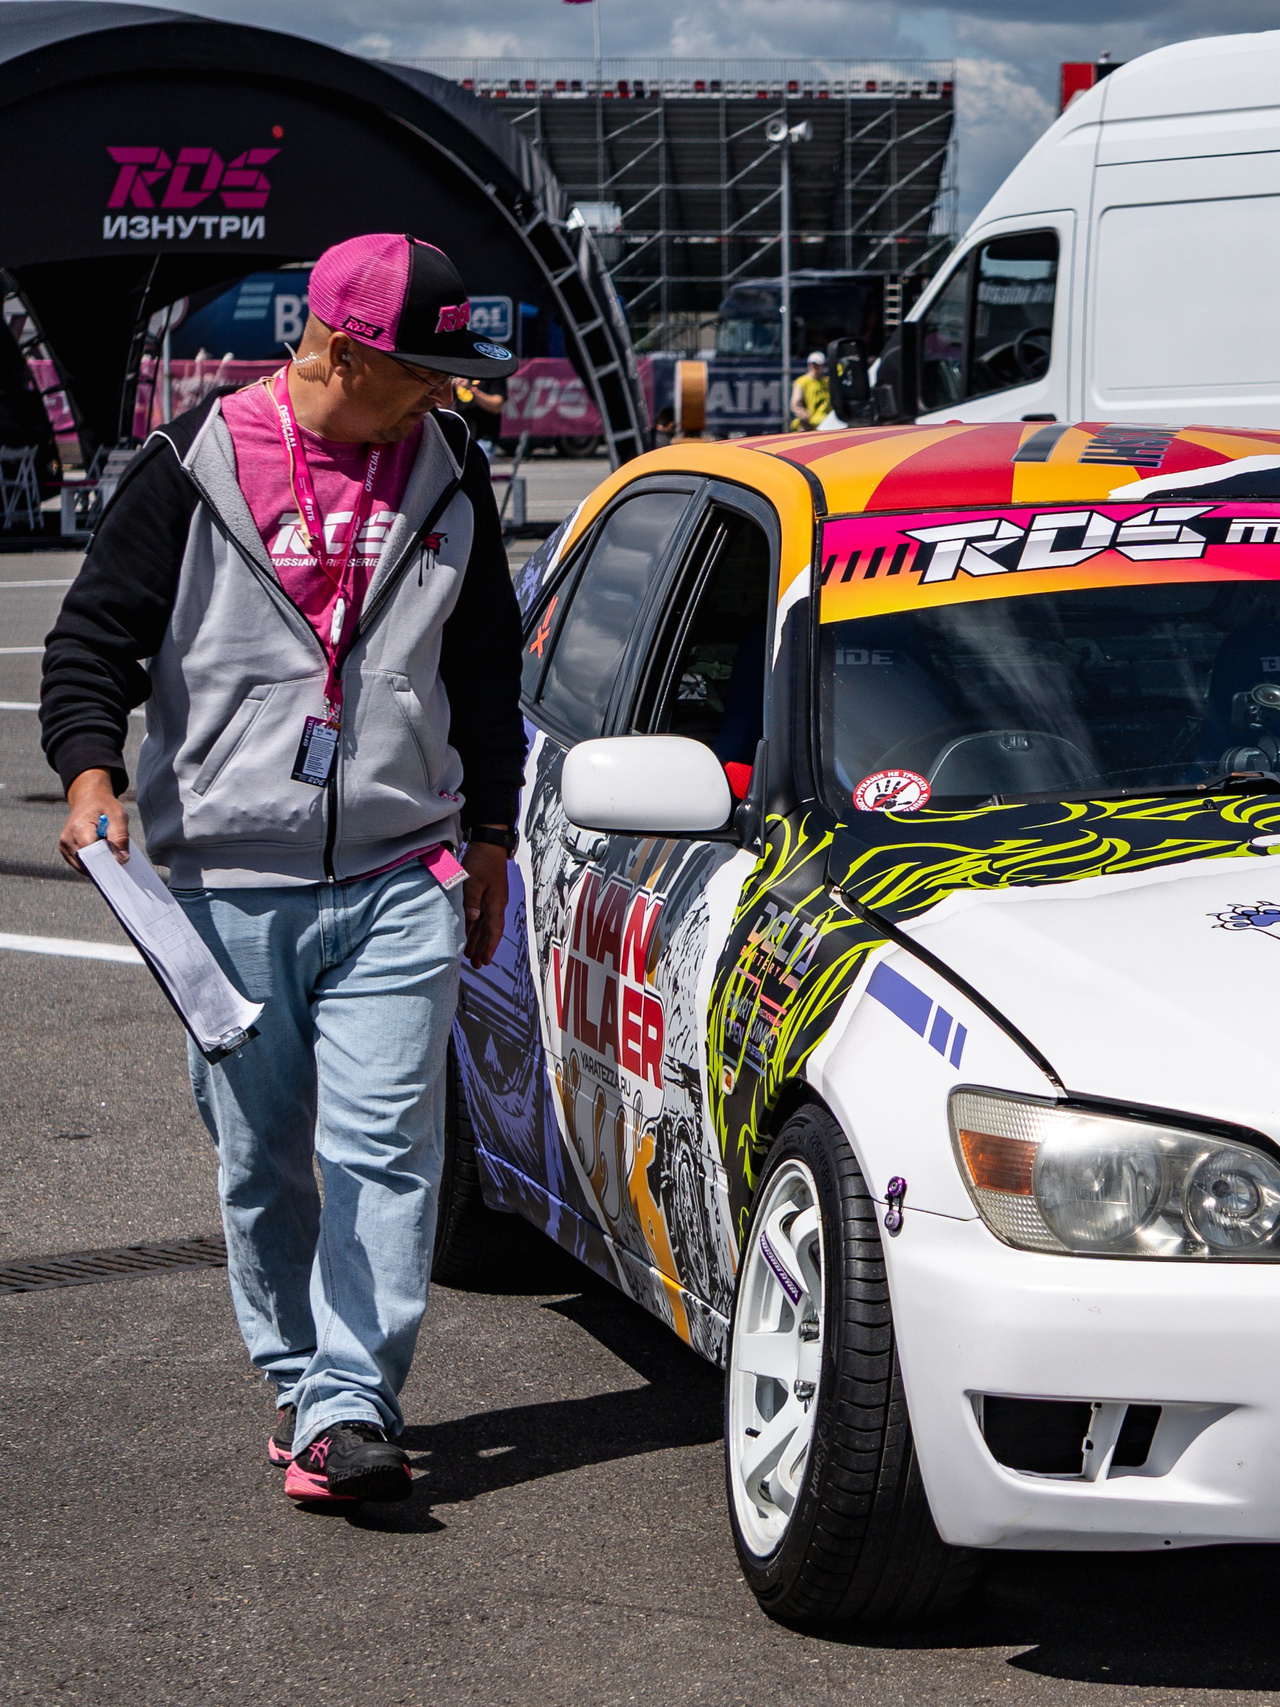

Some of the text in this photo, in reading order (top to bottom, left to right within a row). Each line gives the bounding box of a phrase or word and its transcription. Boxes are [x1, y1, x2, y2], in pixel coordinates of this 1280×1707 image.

[105, 146, 282, 209] RDS
[103, 215, 266, 240] ИЗНУТРИ
[345, 318, 378, 337] RDS
[434, 300, 471, 333] RD
[706, 380, 781, 412] AIM
[278, 403, 298, 450] OFFICIAL
[364, 450, 381, 492] OFFICIAL
[325, 557, 347, 567] RIFT
[347, 557, 380, 567] SERIE
[903, 507, 1217, 584] RDS
[835, 648, 894, 666] IDE
[302, 718, 315, 747] OFFICIAL
[307, 776, 326, 786] RDS
[856, 772, 885, 795] РУКАМИ
[902, 772, 929, 792] ТРОГАТЬ
[573, 870, 663, 986] IVAN
[747, 901, 823, 976] DELTA
[740, 945, 781, 981] BATTERY
[553, 946, 664, 1091] VILAER
[580, 1050, 631, 1098] YARATEZZA.RU
